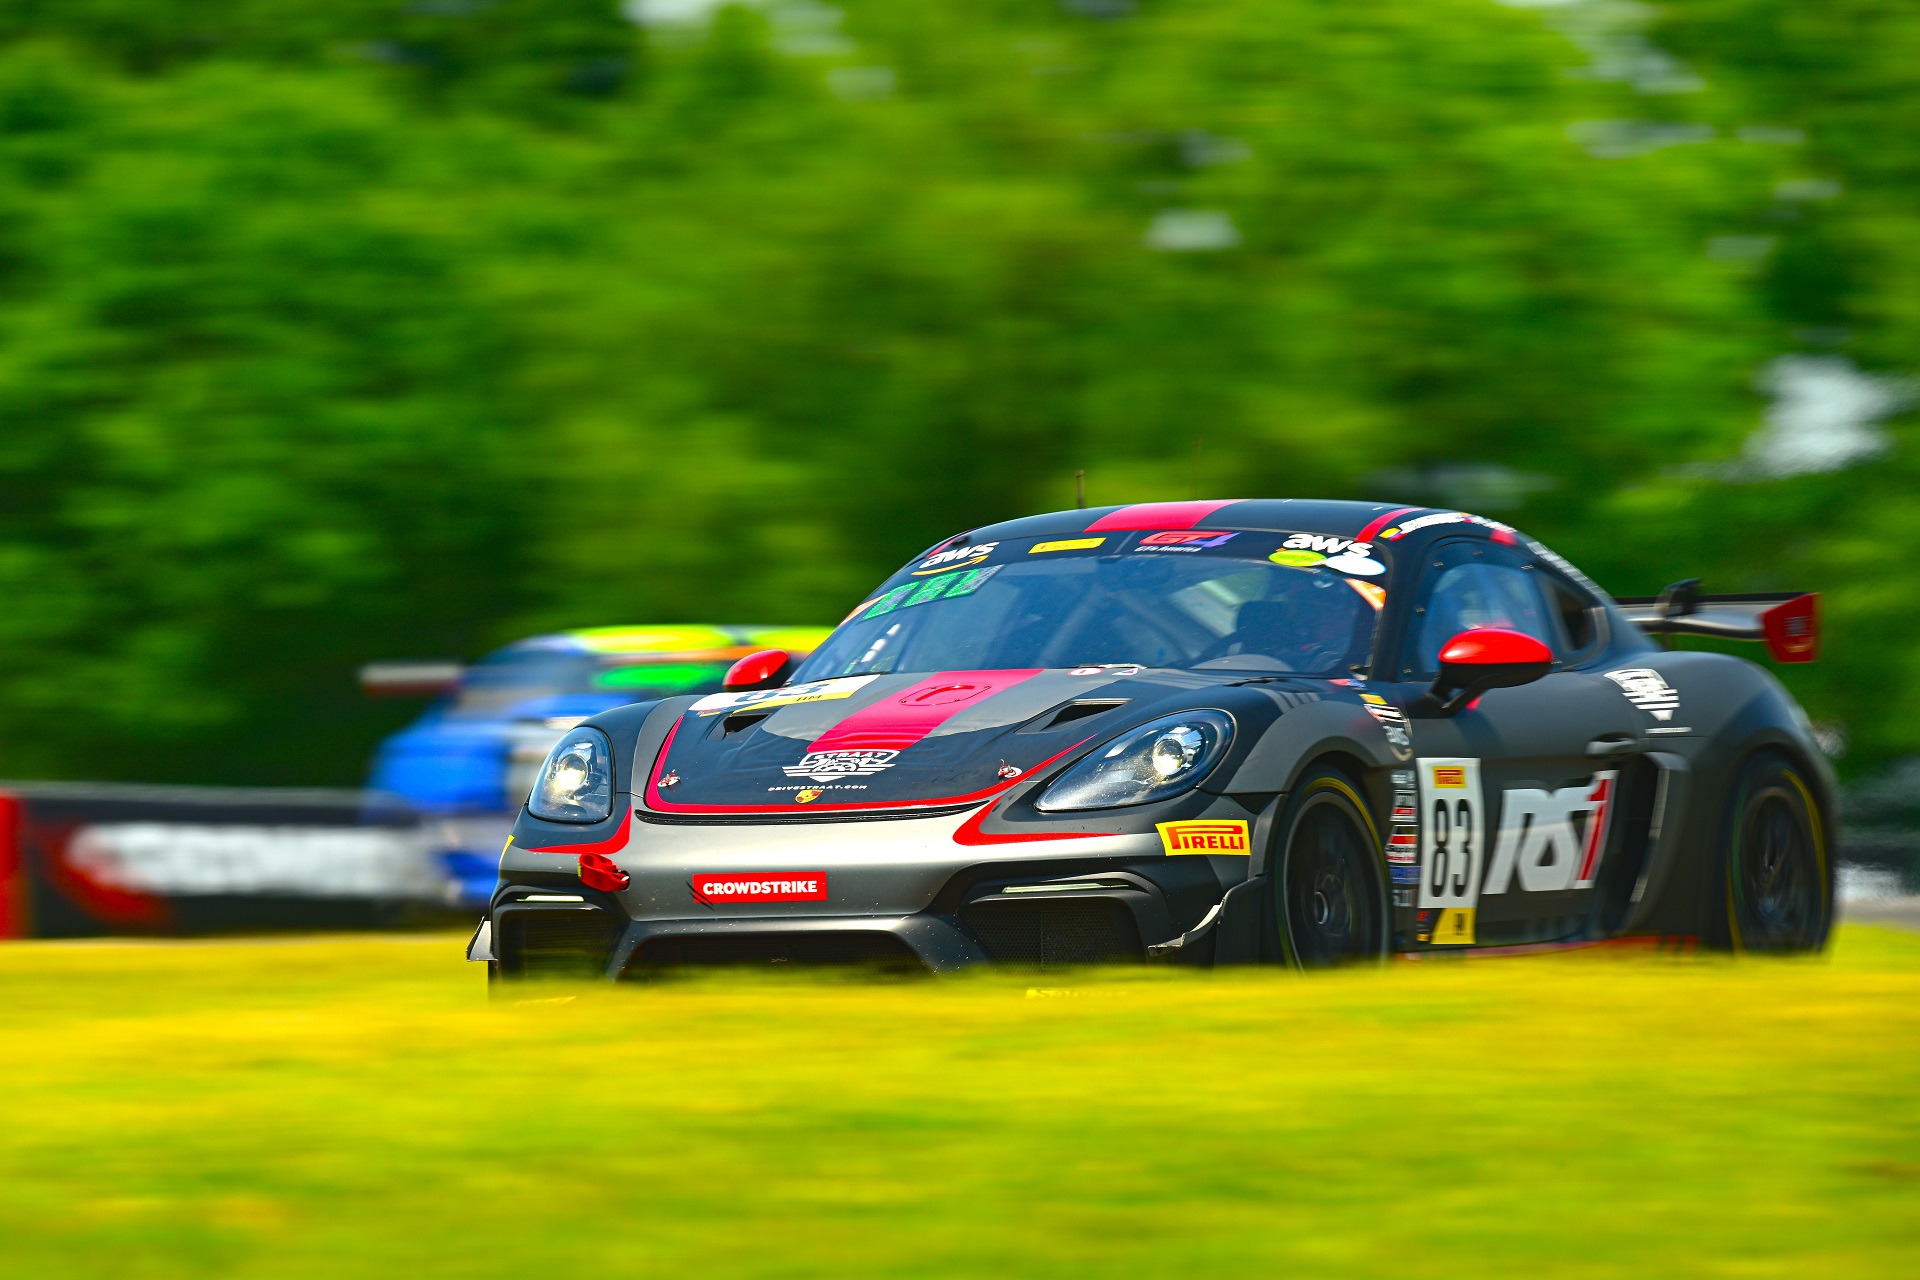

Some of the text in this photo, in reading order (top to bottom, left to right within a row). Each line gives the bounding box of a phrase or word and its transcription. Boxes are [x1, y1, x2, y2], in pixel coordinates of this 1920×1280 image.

[919, 541, 1000, 568] aws
[1283, 534, 1374, 558] aws
[1166, 825, 1244, 849] PIRELLI
[1431, 798, 1473, 898] 83
[702, 880, 818, 895] CROWDSTRIKE
